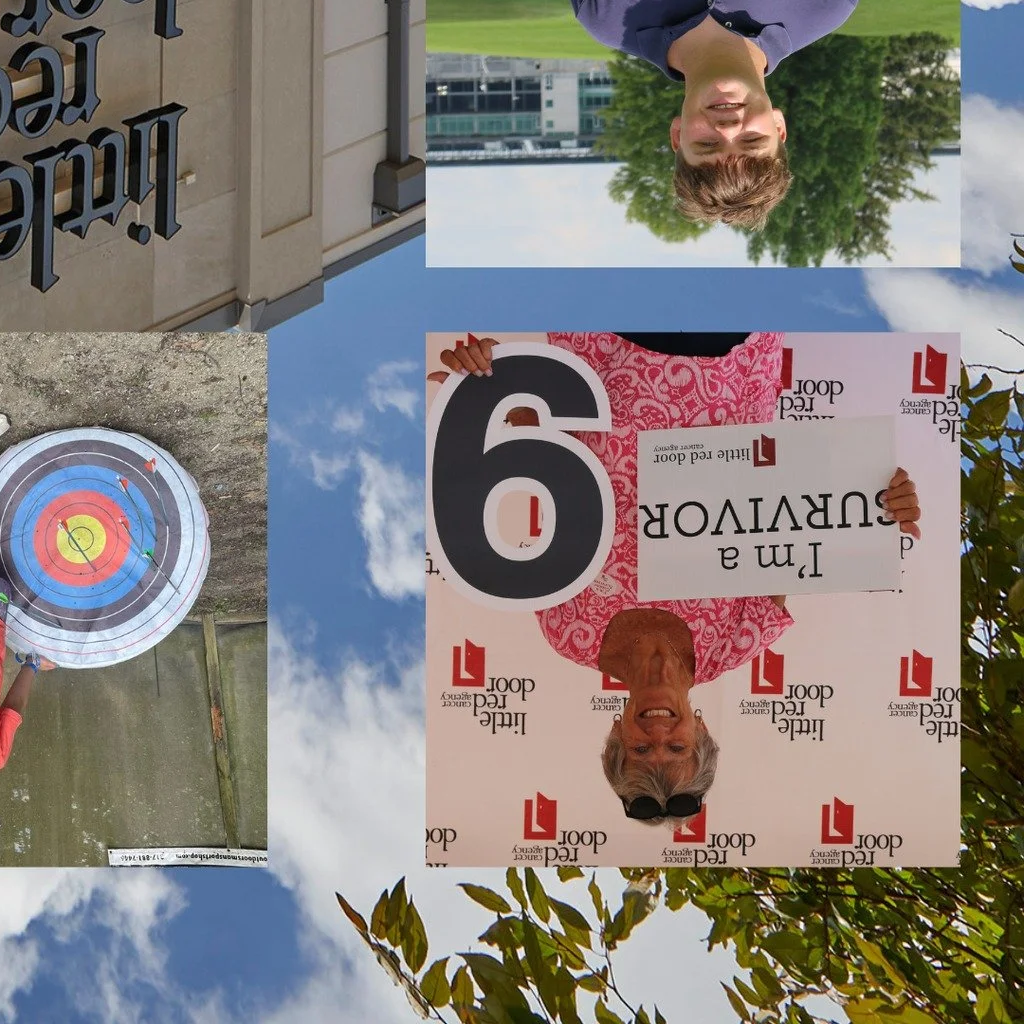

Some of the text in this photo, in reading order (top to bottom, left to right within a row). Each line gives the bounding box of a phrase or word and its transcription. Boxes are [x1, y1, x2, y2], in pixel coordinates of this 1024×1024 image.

[793, 380, 844, 404] door
[780, 396, 815, 420] red
[899, 398, 931, 408] agency
[654, 444, 678, 453] agency
[654, 448, 750, 465] little red door
[432, 355, 603, 600] 9
[638, 488, 896, 540] SURVIVOR
[717, 542, 823, 579] I'm a
[440, 692, 472, 701] agency
[486, 677, 535, 701] door
[784, 684, 834, 707] door
[442, 701, 471, 709] cancer
[473, 693, 508, 716] red
[590, 695, 622, 706] agency
[592, 704, 622, 712] cancer
[739, 699, 770, 709] agency
[888, 702, 918, 710] agency
[741, 708, 770, 716] cancer
[770, 700, 805, 723] red
[889, 710, 918, 718] cancer
[919, 703, 954, 726] red
[479, 711, 527, 735] little
[778, 718, 825, 741] little
[926, 721, 960, 743] ttle
[512, 845, 543, 854] agency
[558, 830, 607, 854] door
[707, 833, 755, 855] door
[855, 834, 902, 856] door
[544, 847, 579, 867] red
[661, 848, 692, 857] agency
[663, 856, 692, 864] cancer
[693, 849, 728, 867] red
[809, 849, 840, 859] agency
[842, 850, 874, 868] red
[811, 858, 840, 866] cancer
